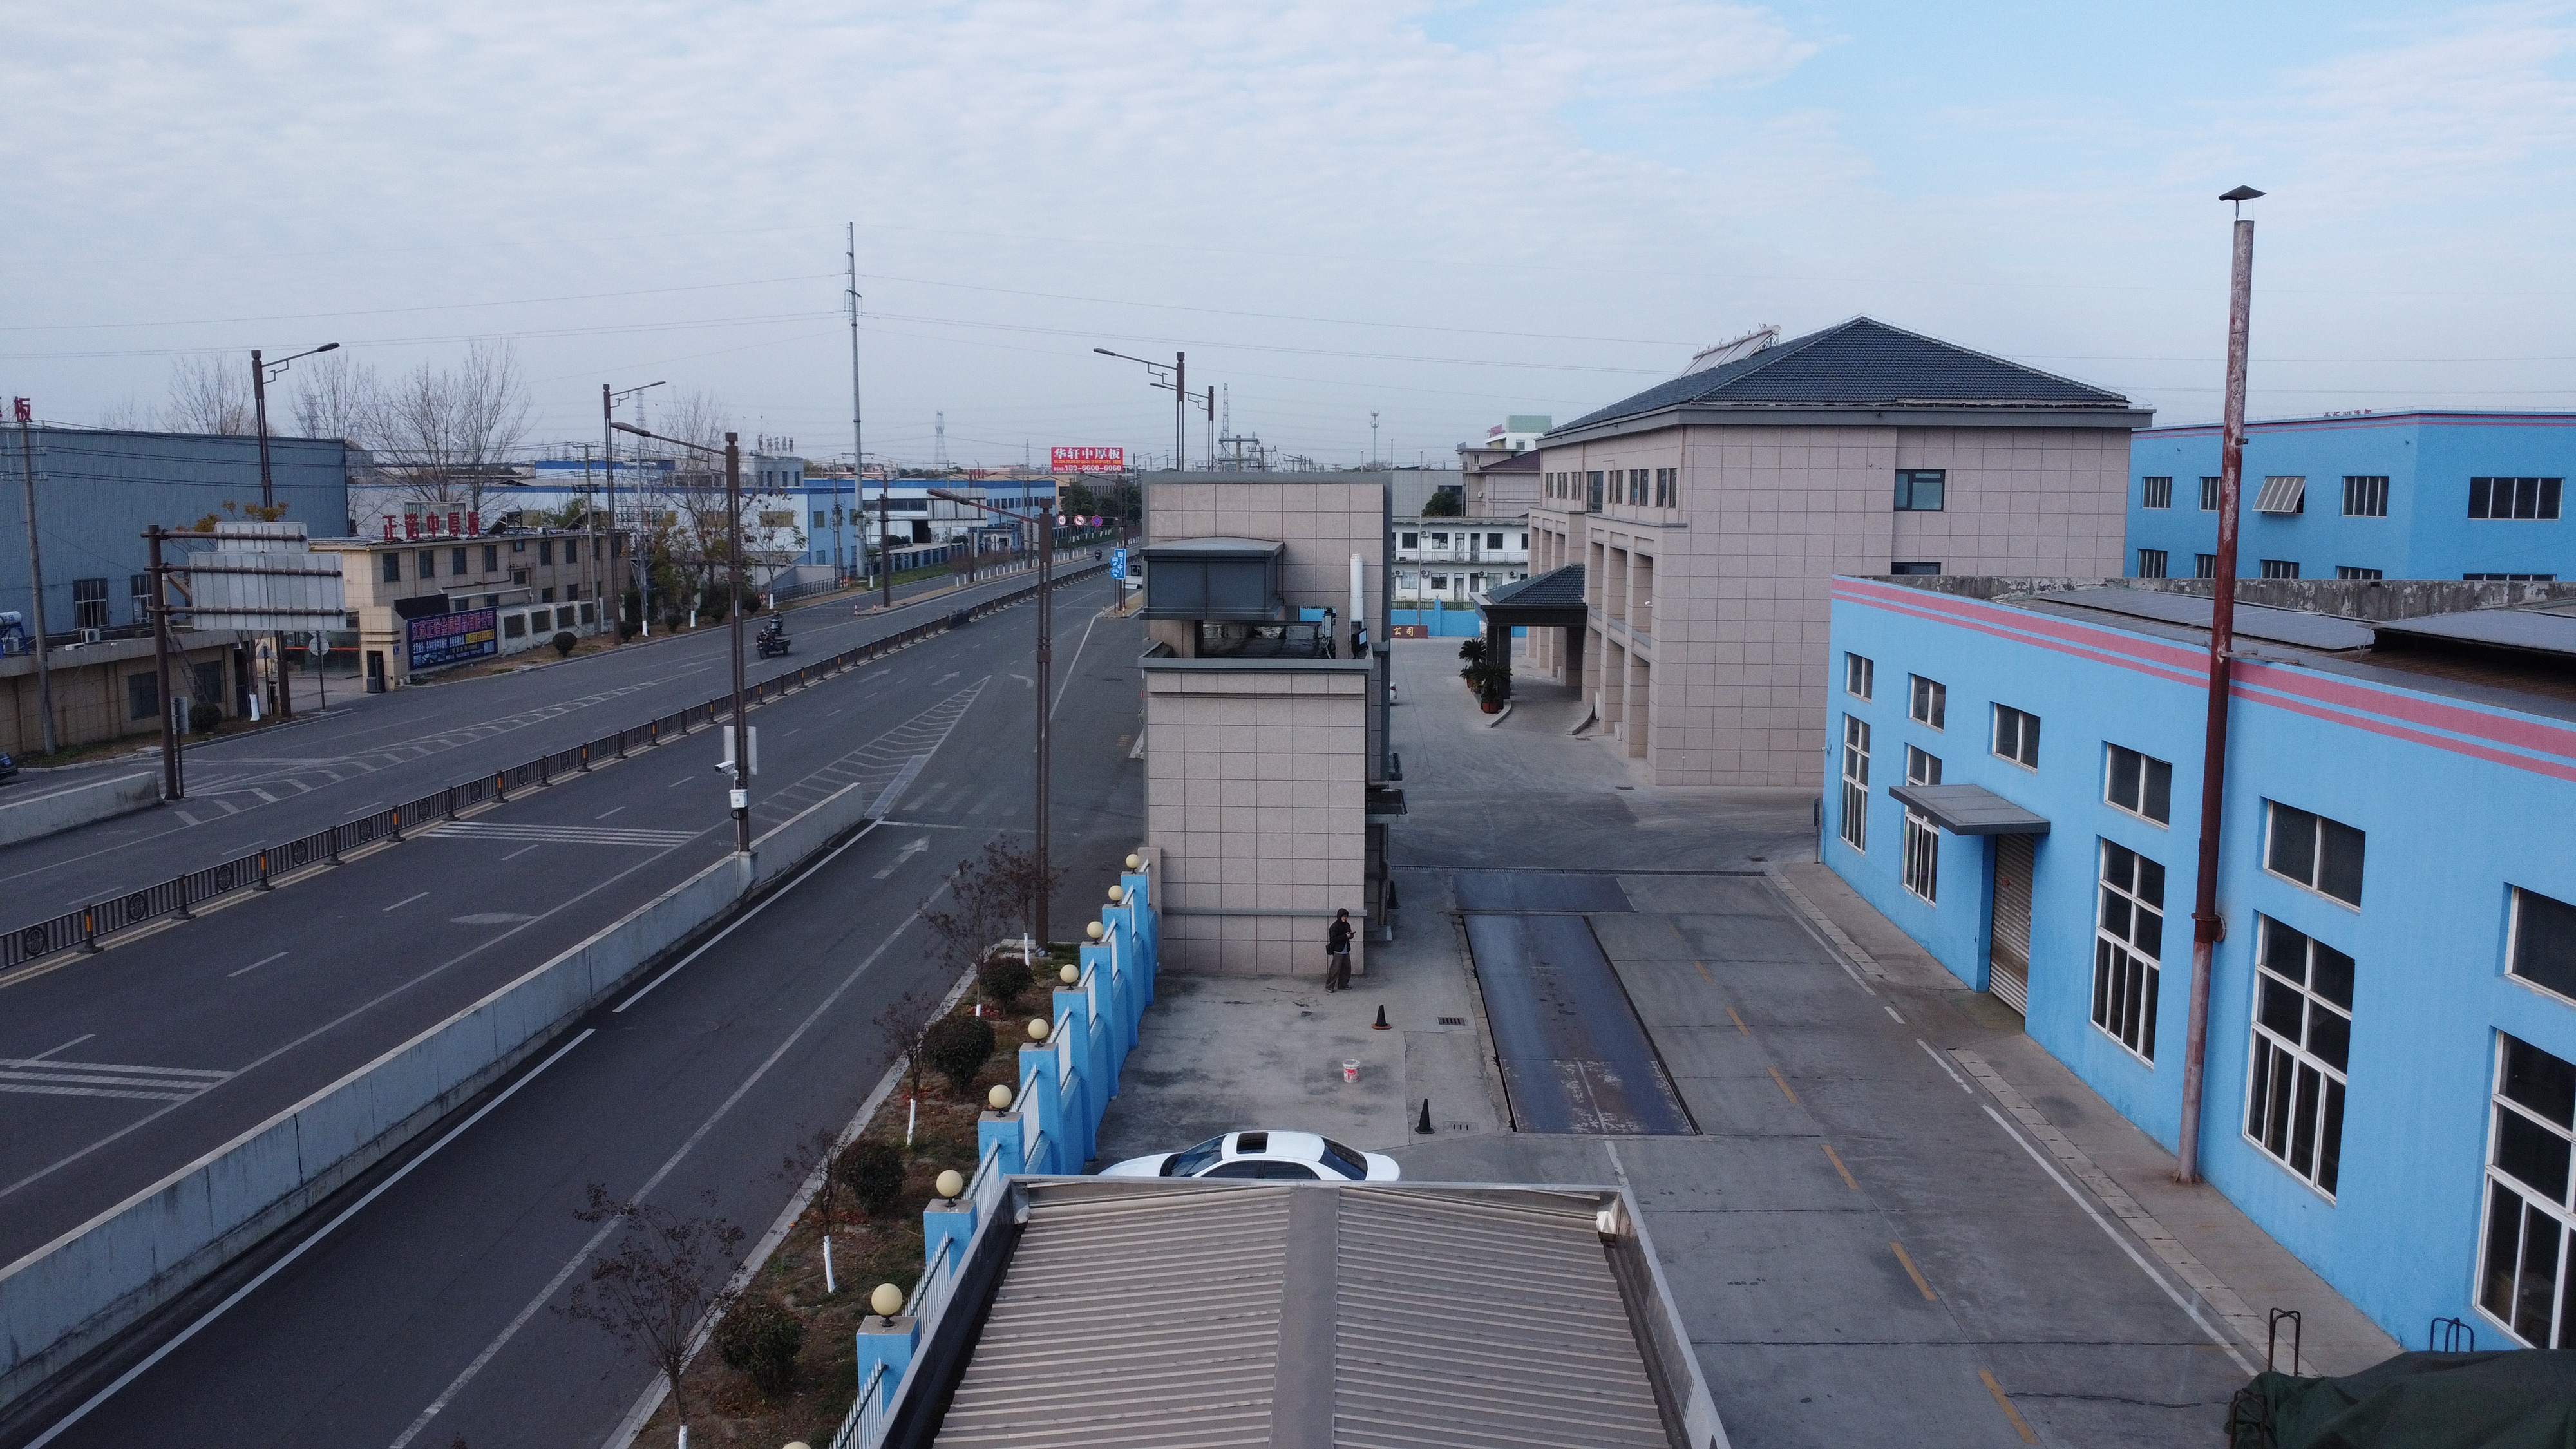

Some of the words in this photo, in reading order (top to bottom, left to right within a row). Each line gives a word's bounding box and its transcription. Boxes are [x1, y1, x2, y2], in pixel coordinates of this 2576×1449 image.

[1054, 448, 1121, 459] 华轩中厚板
[1393, 626, 1414, 637] 公司
